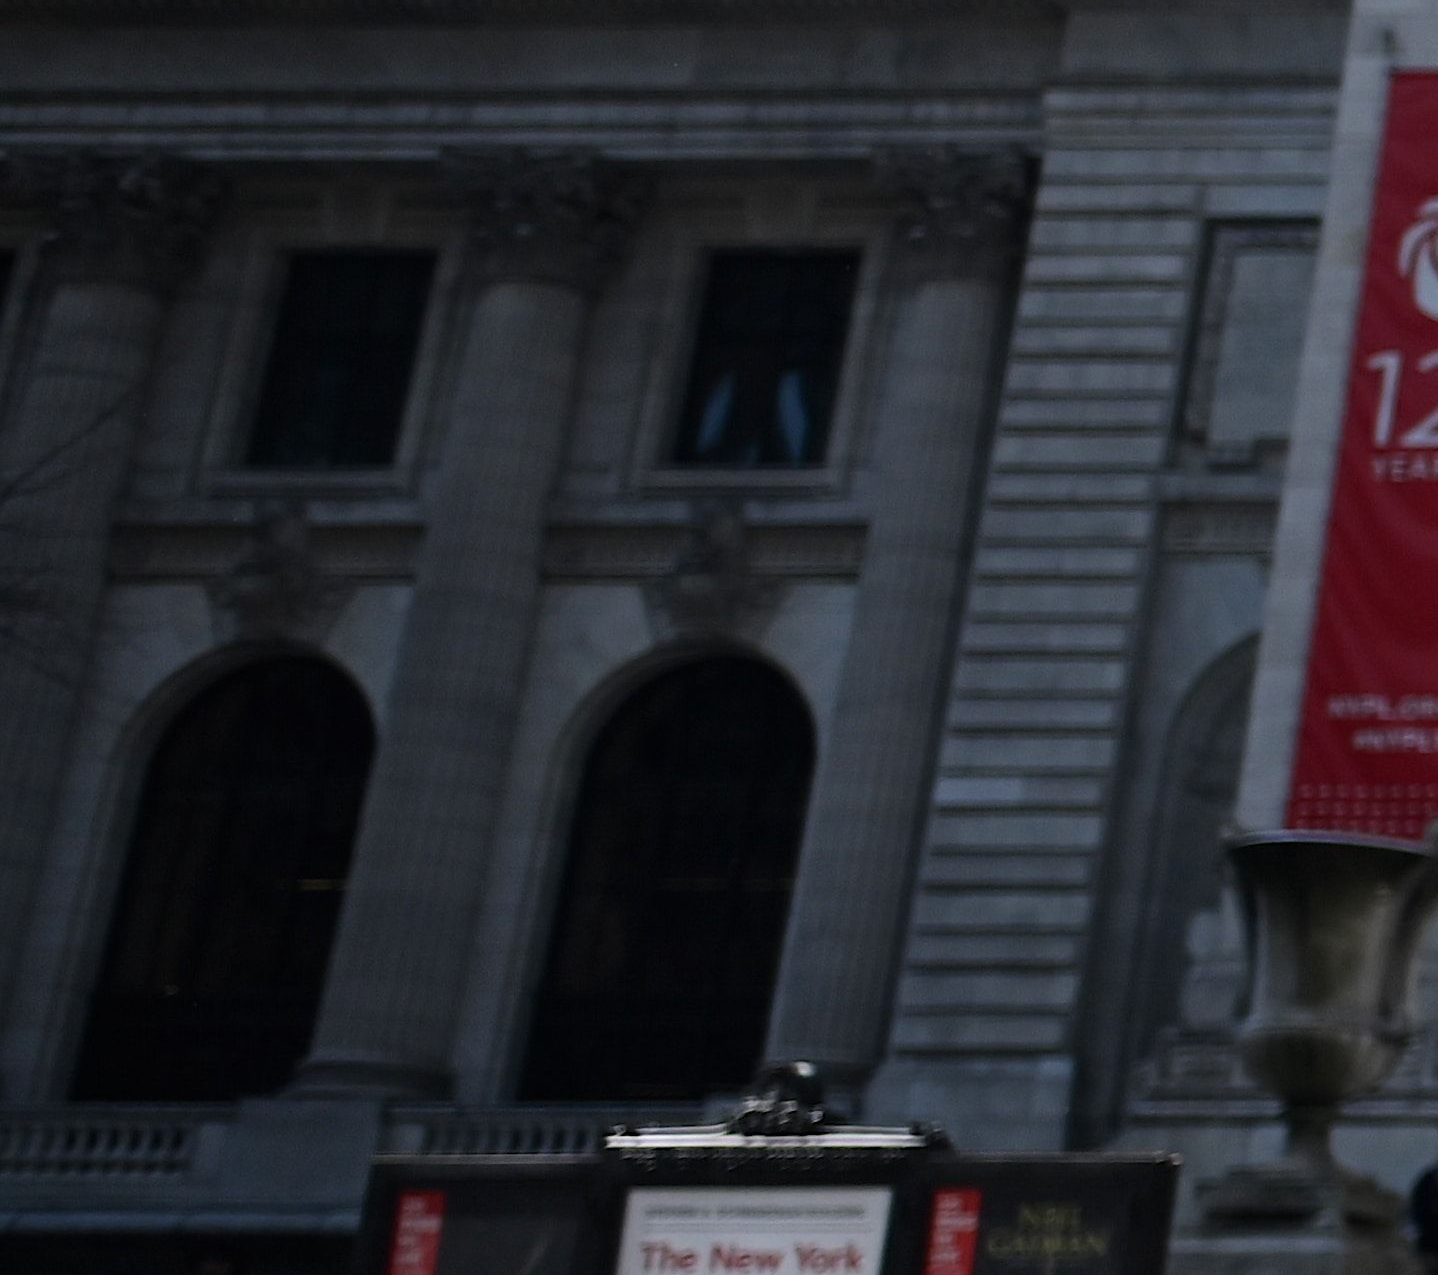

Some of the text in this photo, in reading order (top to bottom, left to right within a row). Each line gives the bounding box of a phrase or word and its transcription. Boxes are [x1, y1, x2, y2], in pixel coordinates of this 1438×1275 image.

[640, 1241, 864, 1274] The New York
